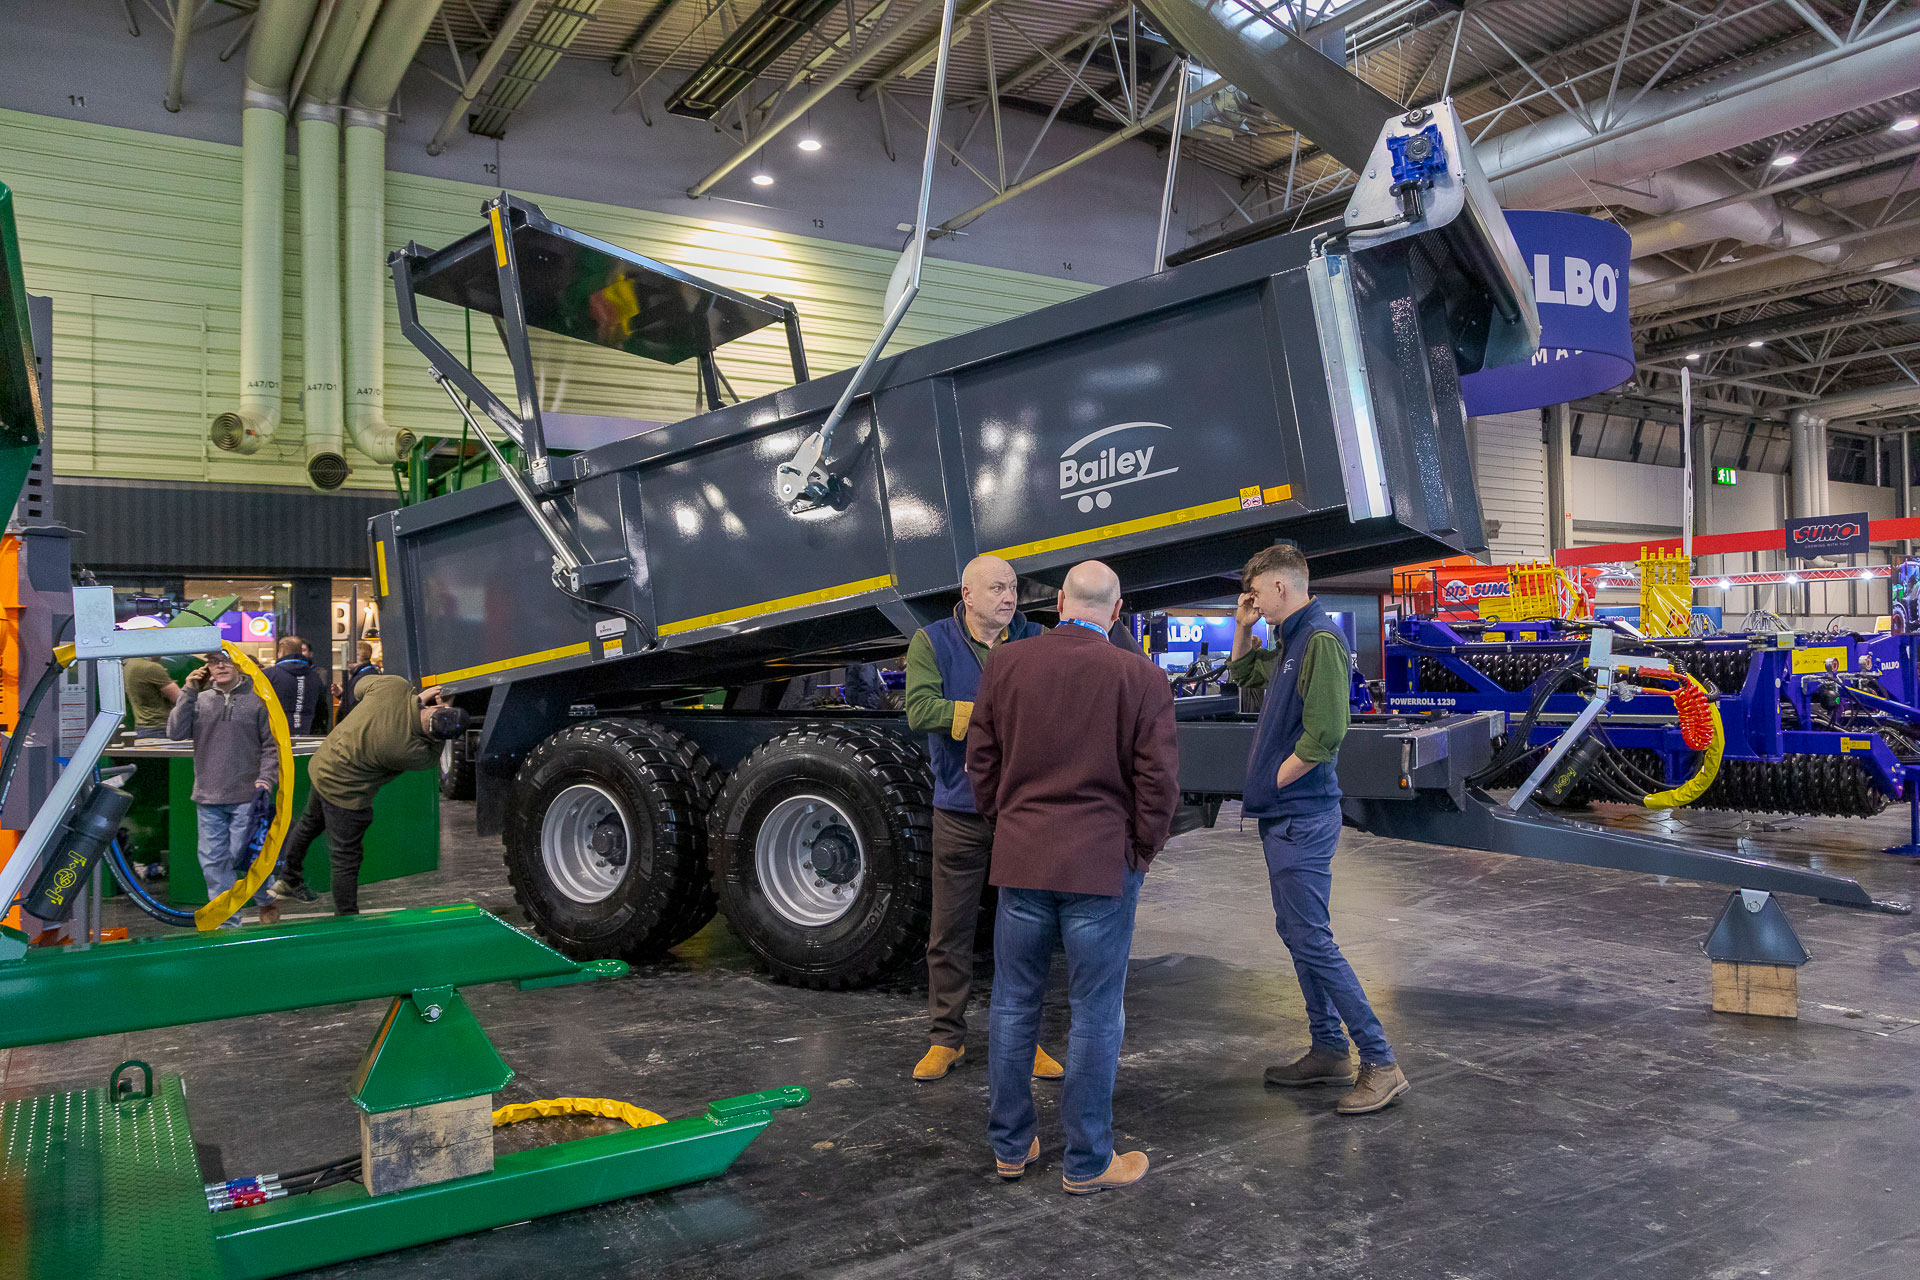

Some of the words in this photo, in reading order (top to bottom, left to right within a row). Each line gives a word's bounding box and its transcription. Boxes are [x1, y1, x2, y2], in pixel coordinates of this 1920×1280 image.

[67, 95, 84, 107] 11
[483, 163, 497, 174] 12
[812, 218, 824, 228] 13
[1063, 262, 1072, 270] 14
[1533, 253, 1617, 313] LBO
[1059, 445, 1155, 490] Bailey
[1796, 522, 1856, 544] SUMO
[1881, 660, 1900, 671] DALBO
[1390, 697, 1436, 706] POWERROLL
[1437, 697, 1456, 706] 1230
